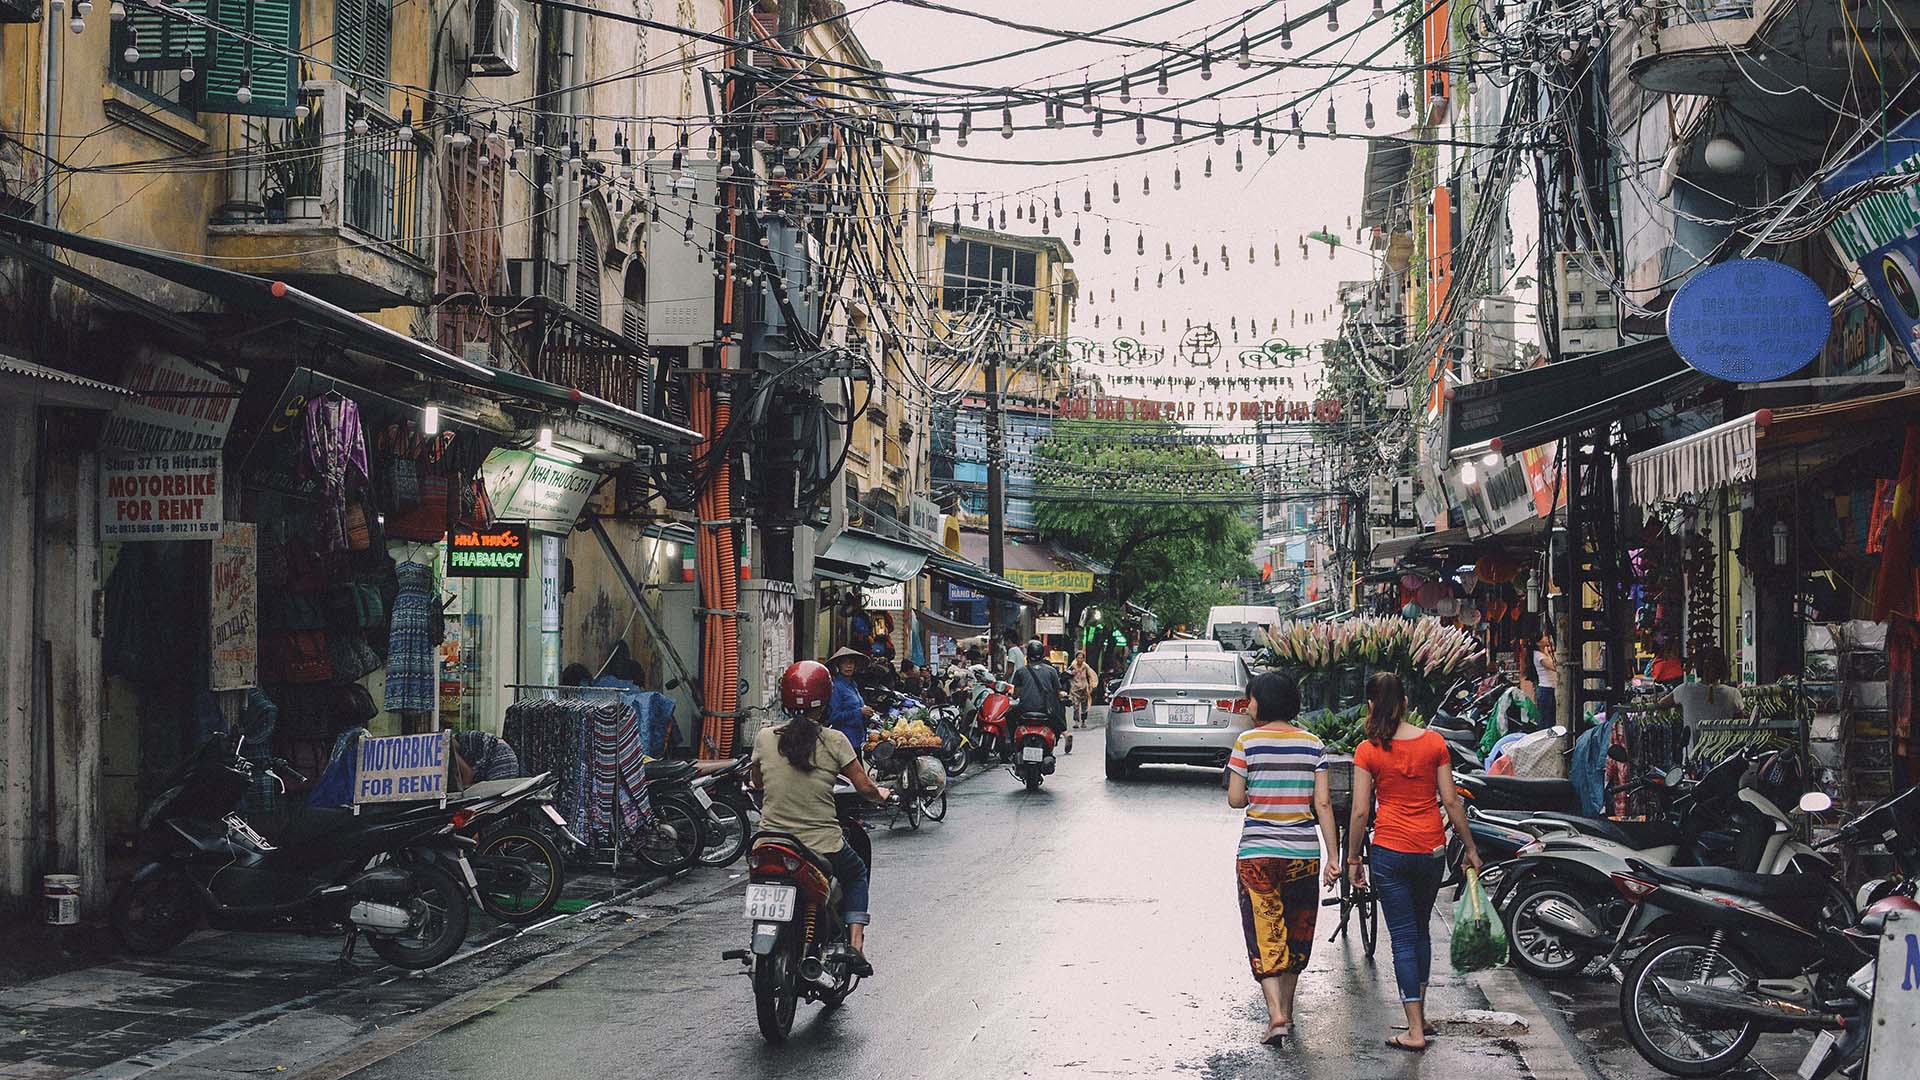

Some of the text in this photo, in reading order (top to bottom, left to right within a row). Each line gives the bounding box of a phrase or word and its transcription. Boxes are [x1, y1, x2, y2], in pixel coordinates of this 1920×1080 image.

[108, 474, 216, 498] MOTORBIKE
[117, 499, 205, 521] FOR RENT
[451, 551, 524, 568] PHARMACY
[361, 734, 443, 772] MOTORBIKE
[361, 774, 442, 797] FOR RENT
[750, 903, 787, 919] 8105
